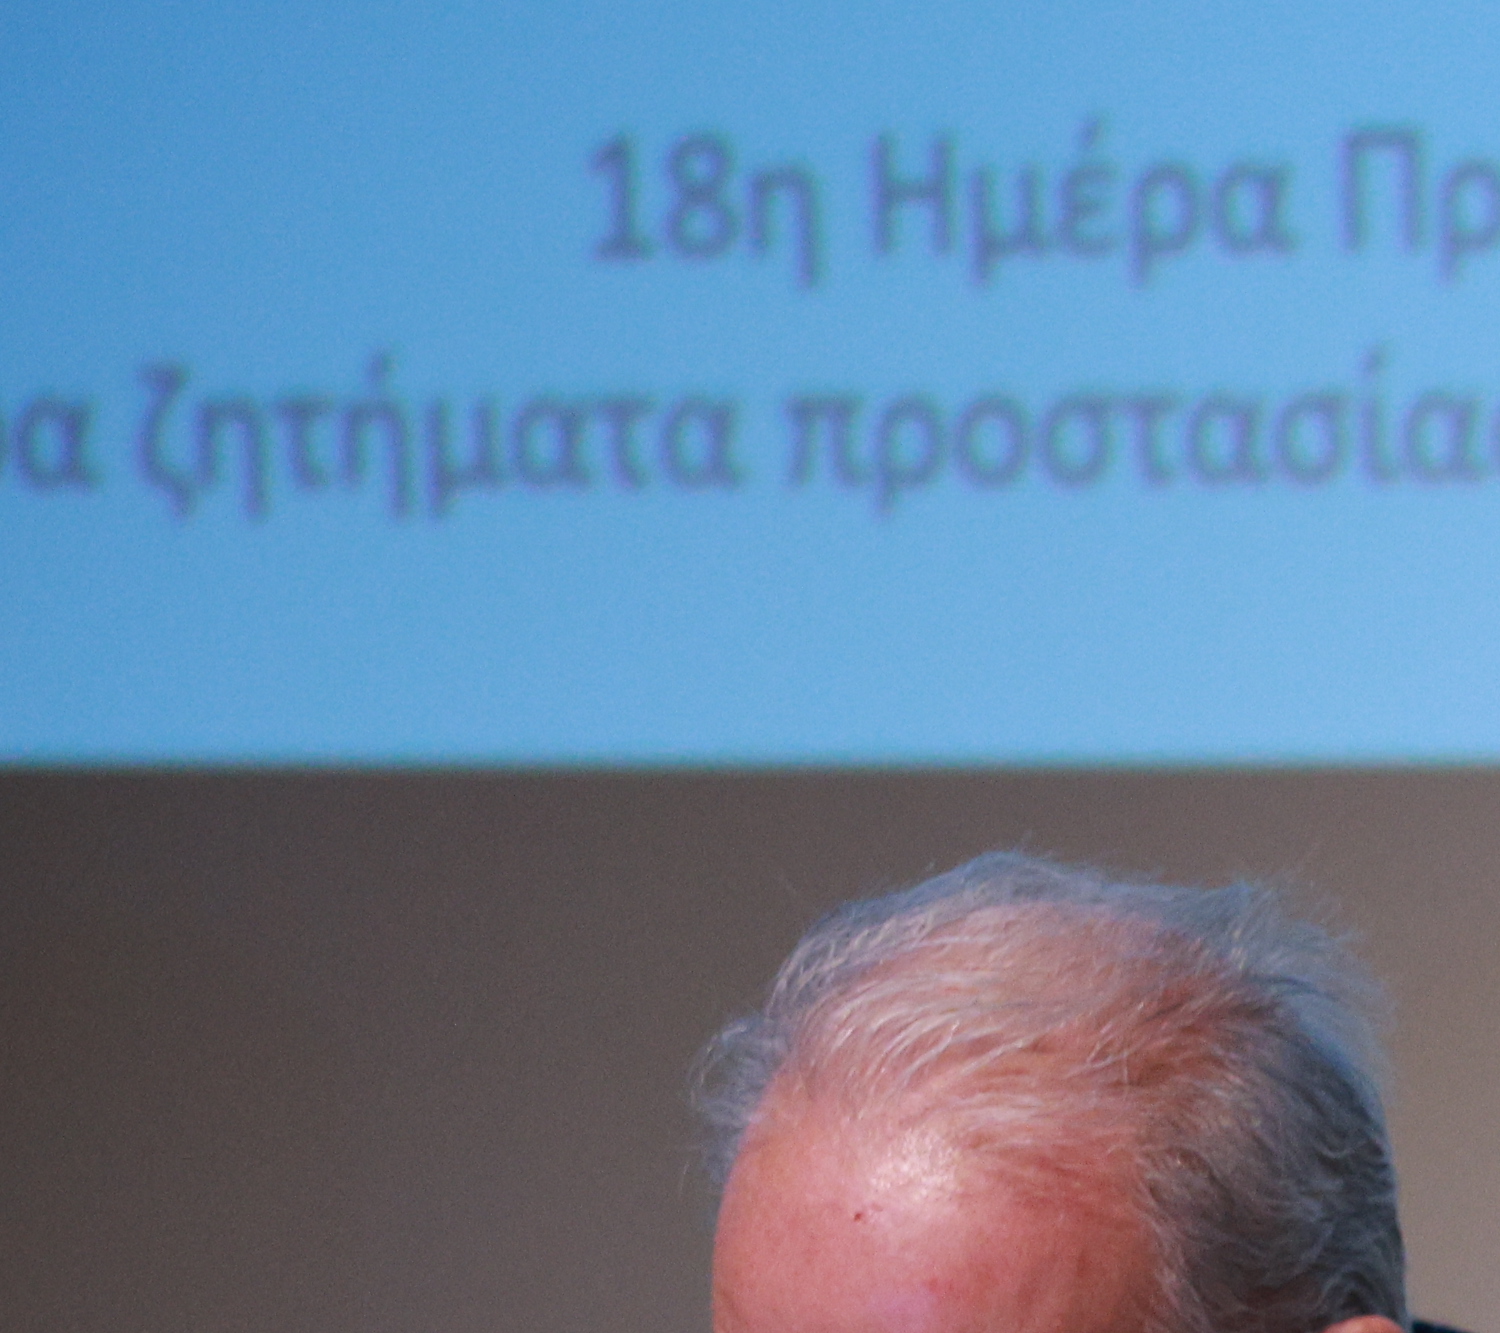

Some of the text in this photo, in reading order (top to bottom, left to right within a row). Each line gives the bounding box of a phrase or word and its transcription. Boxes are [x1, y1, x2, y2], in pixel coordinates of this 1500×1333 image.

[588, 134, 822, 284] 18η
[868, 118, 1294, 284] Ημέρα
[132, 350, 744, 520] ζητήματα
